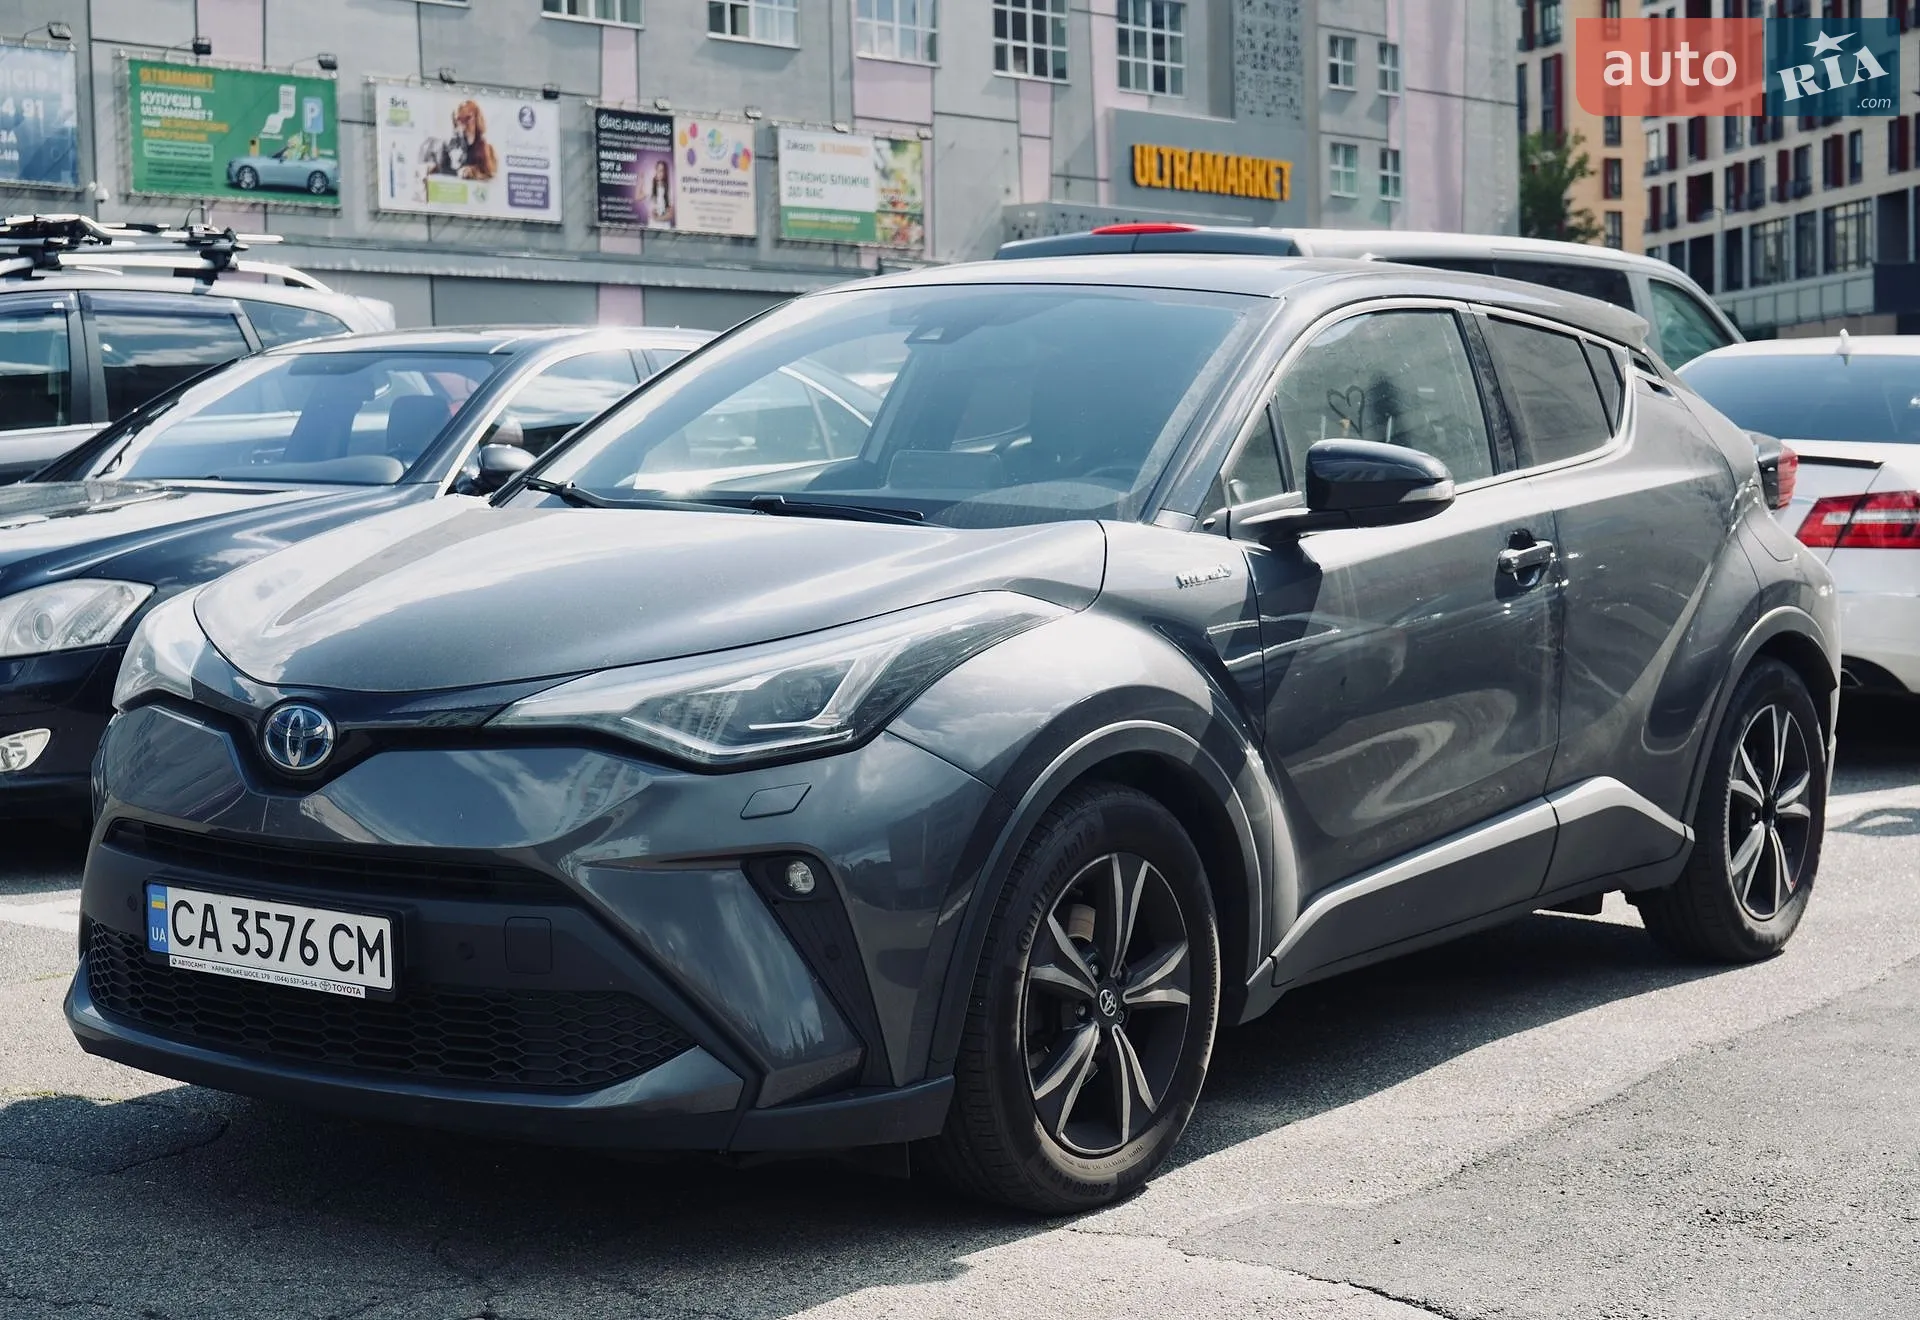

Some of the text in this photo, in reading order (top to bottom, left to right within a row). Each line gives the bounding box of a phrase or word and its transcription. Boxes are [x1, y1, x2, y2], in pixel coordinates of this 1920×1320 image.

[1131, 144, 1293, 202] ULTRAMARKET
[151, 927, 167, 943] UA
[171, 900, 386, 978] CA 3576 CM
[332, 983, 362, 996] TOYOTA
